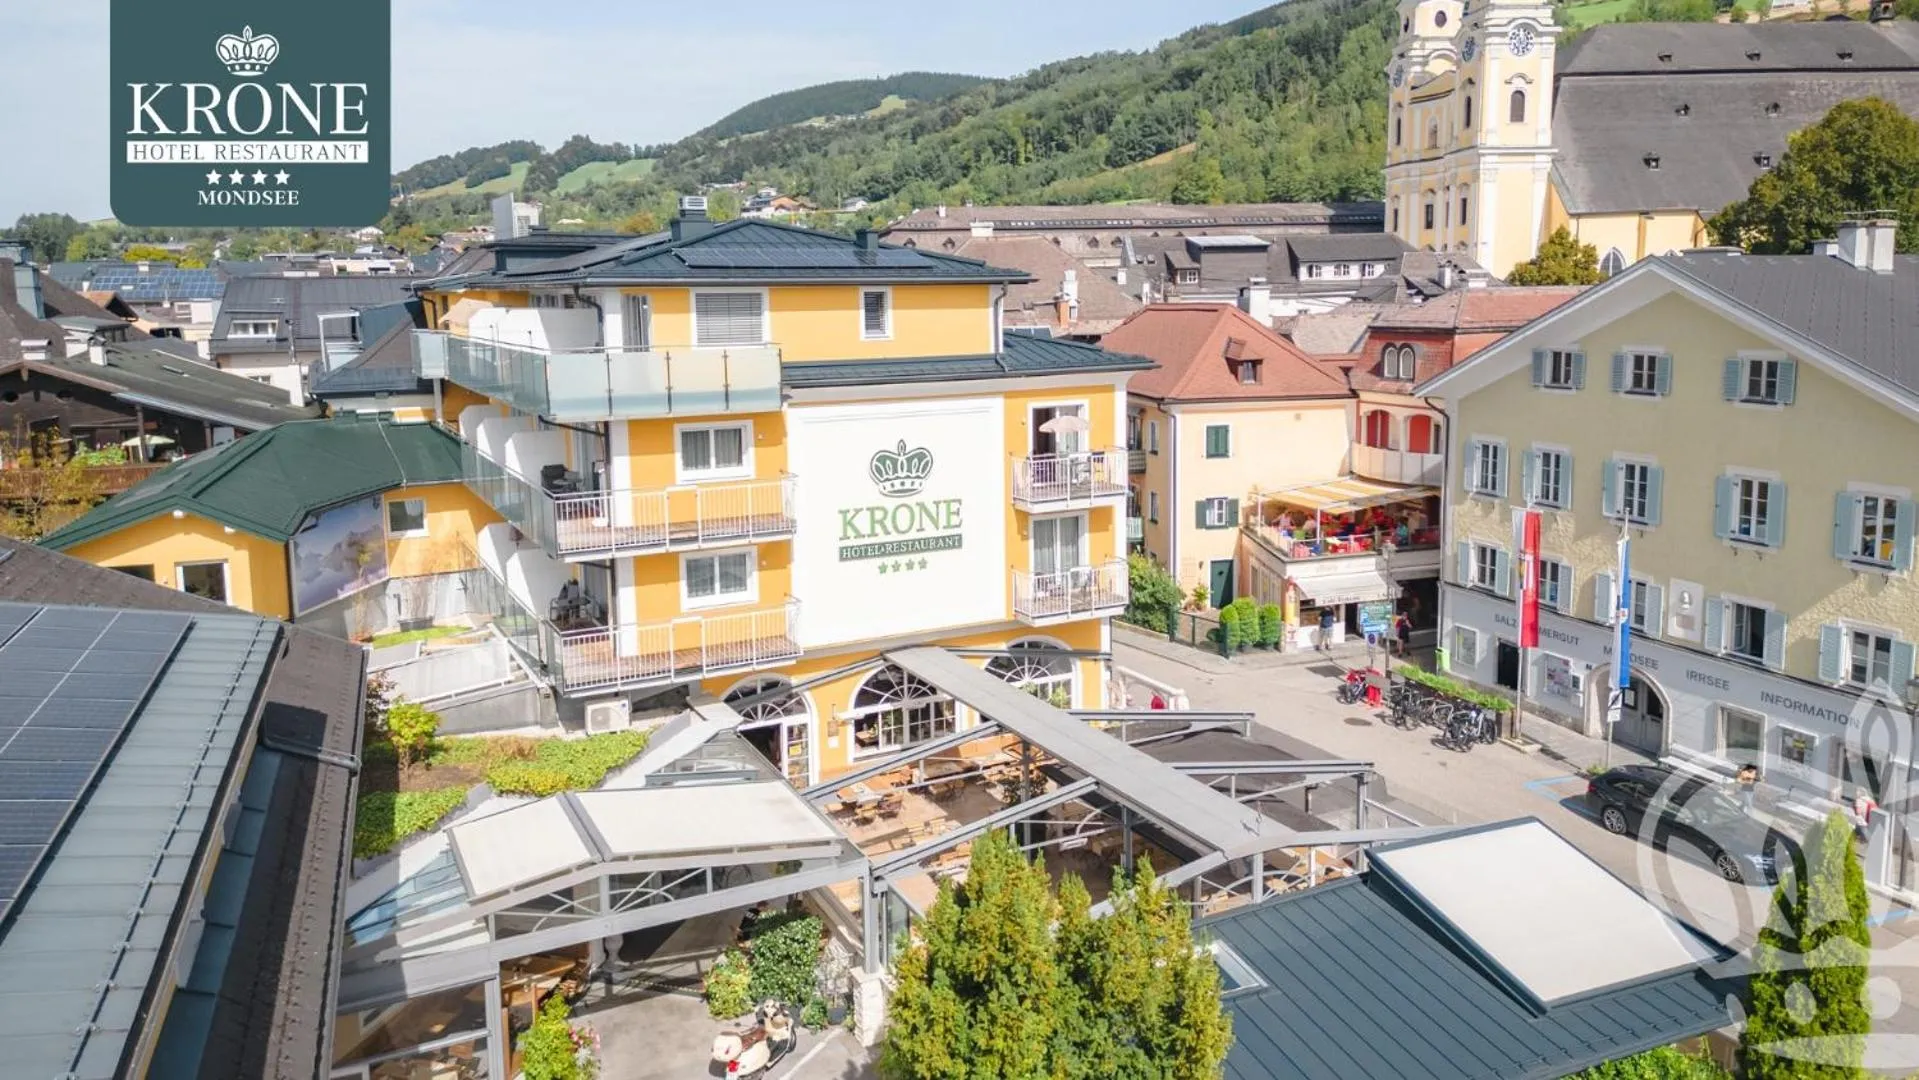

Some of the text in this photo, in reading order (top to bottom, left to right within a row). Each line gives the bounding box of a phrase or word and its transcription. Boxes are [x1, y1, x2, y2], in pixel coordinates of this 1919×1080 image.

[838, 499, 963, 541] KRONE
[1494, 613, 1579, 646] SALZMERGUT
[1603, 646, 1659, 670] MDSEE
[1686, 669, 1730, 691] IRRSEE
